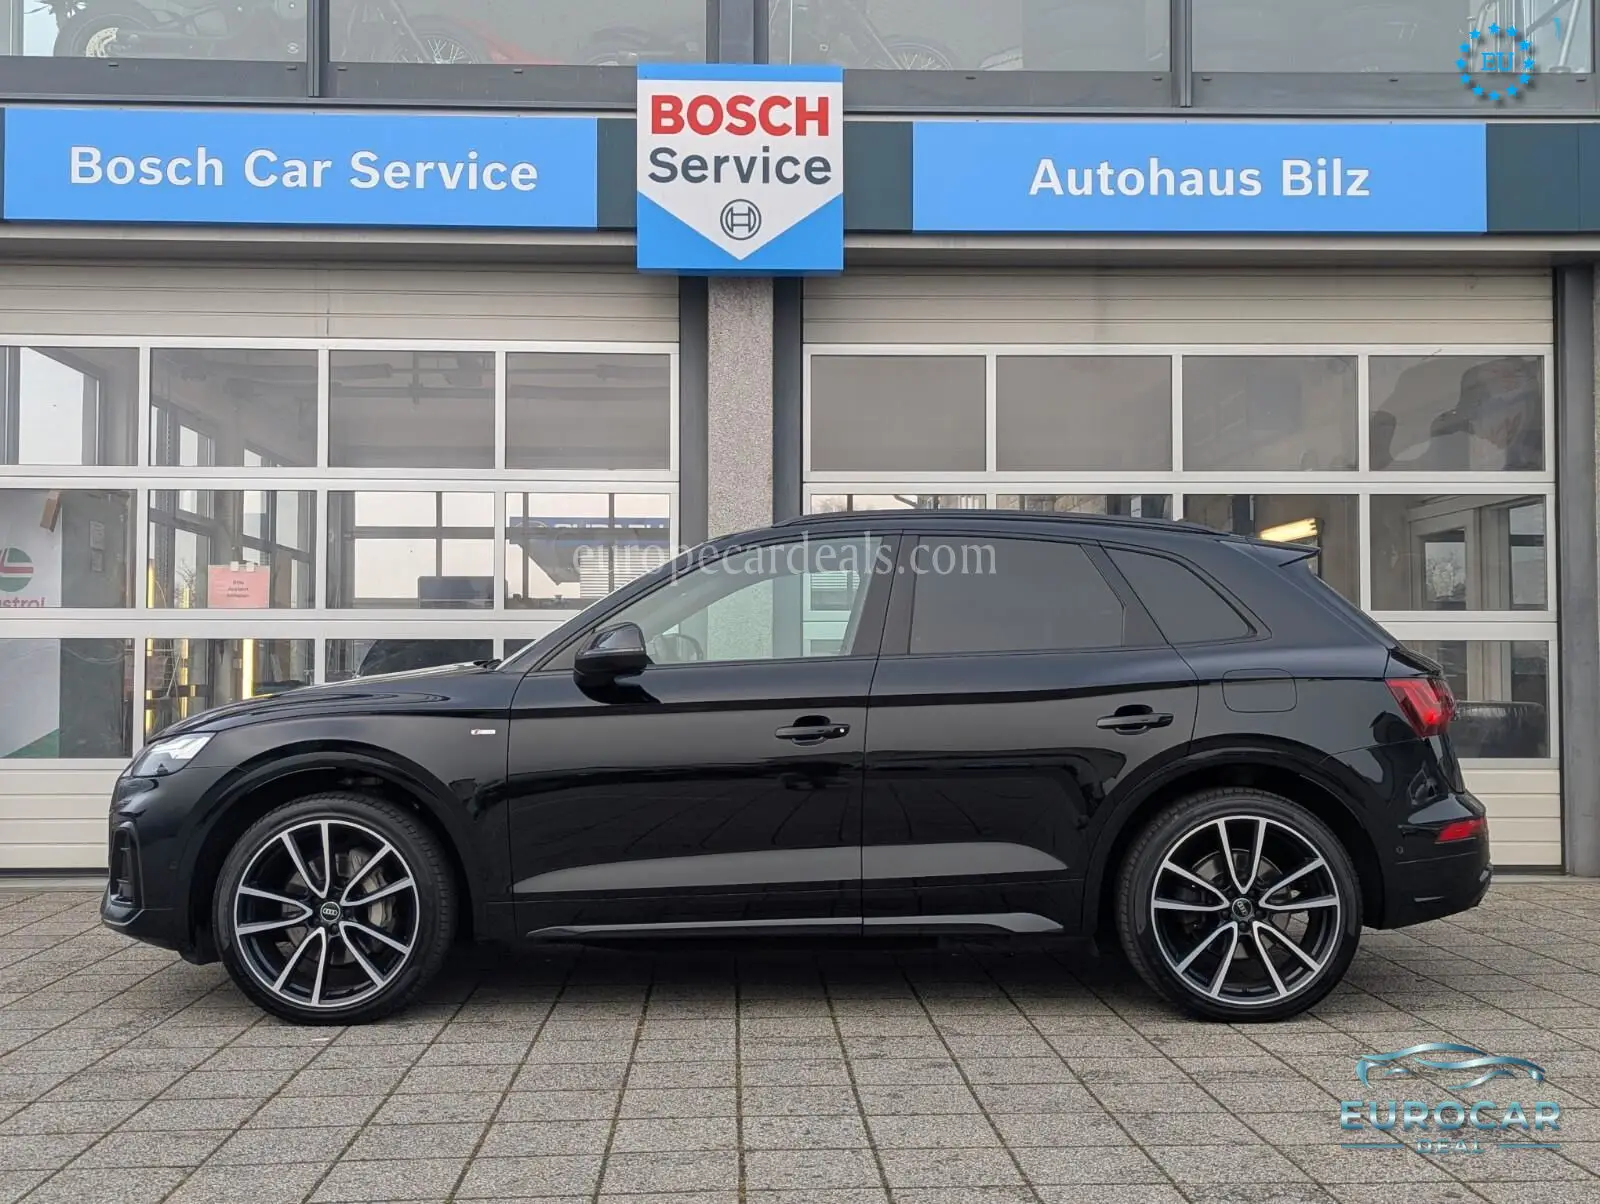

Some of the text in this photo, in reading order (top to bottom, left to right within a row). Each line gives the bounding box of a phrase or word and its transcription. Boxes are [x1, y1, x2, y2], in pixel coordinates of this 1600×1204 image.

[651, 94, 830, 137] BOSCH
[69, 145, 539, 192] Bosch Car Service
[648, 145, 832, 185] Service
[1029, 157, 1371, 197] Autohaus Bilz
[0, 596, 45, 608] strol
